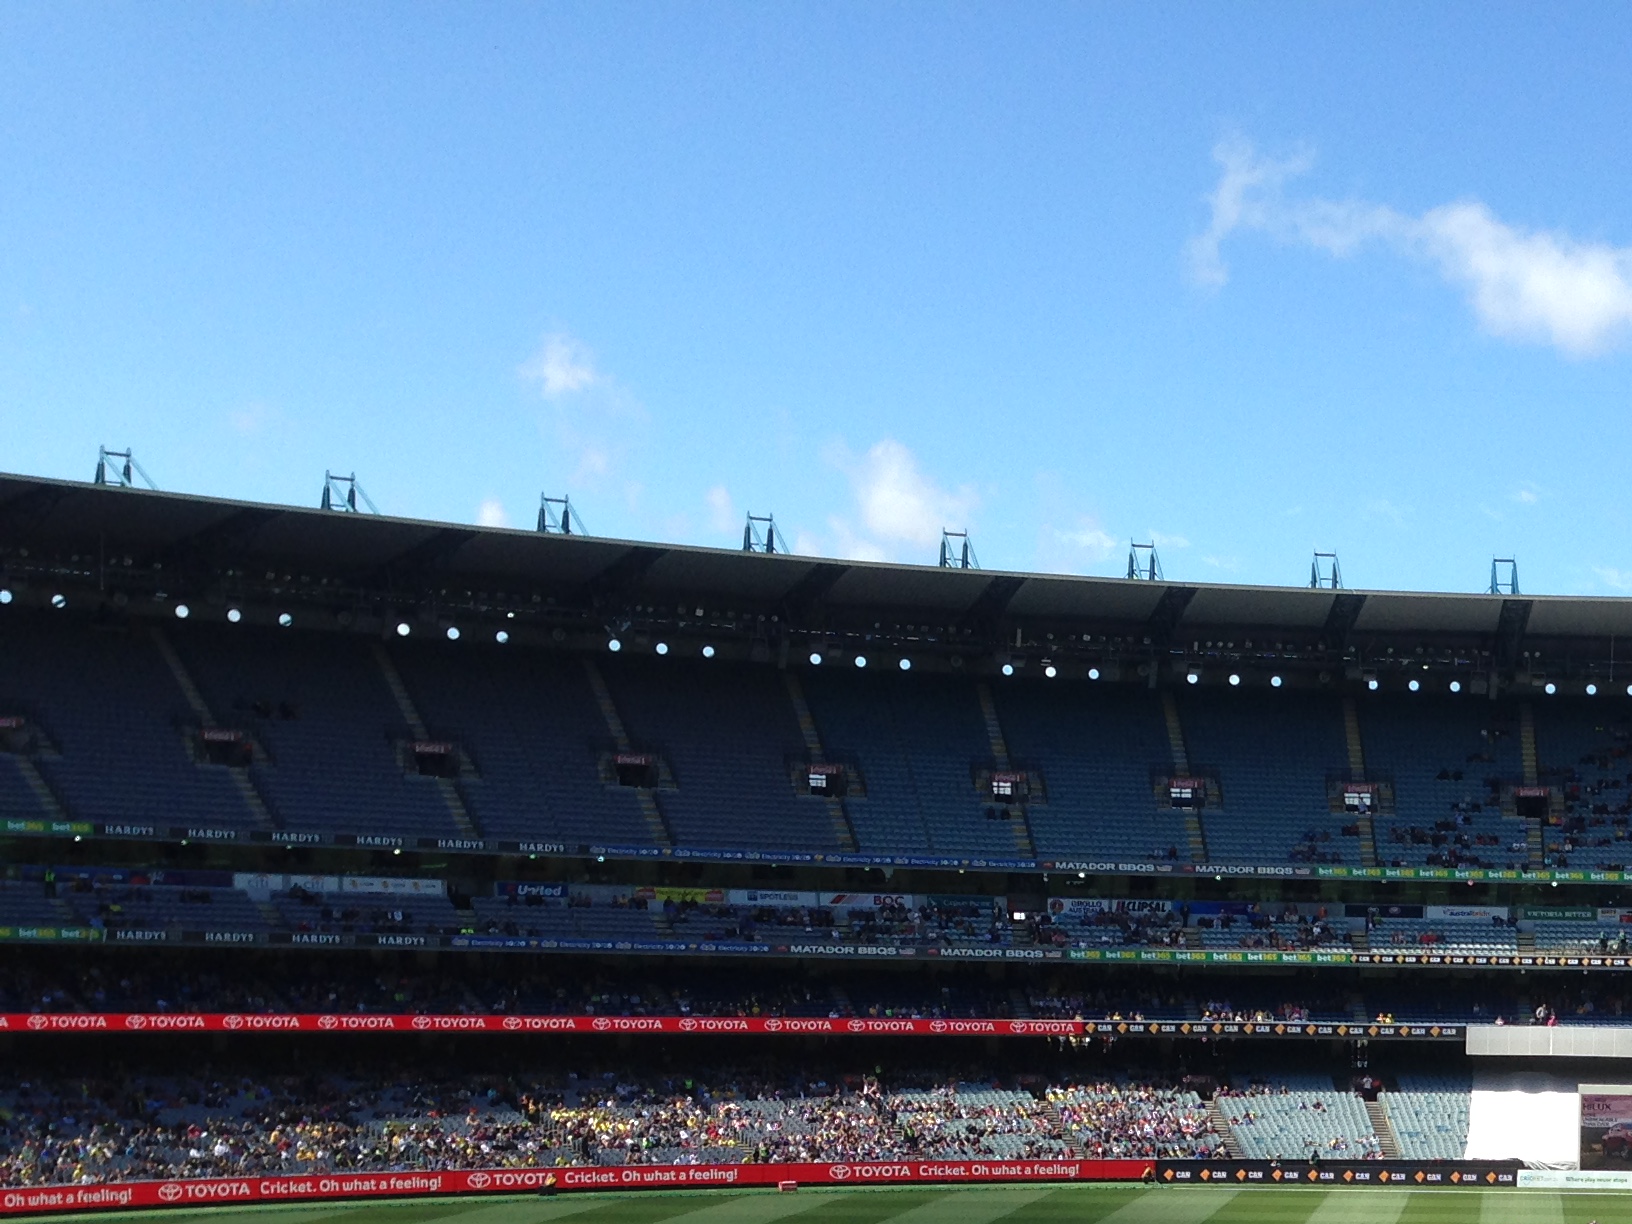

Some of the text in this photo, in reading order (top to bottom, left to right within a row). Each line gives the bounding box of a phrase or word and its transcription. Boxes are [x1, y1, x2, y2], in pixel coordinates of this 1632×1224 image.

[1056, 862, 1115, 870] MATADOR
[1126, 901, 1166, 912] CLIPSAL
[50, 1016, 106, 1027] TOYOTA
[245, 1017, 299, 1027] TOYOTA
[341, 1018, 394, 1027] TOYOTA
[434, 1018, 485, 1027] TOYOTA
[524, 1019, 575, 1028] TOYOTA
[613, 1020, 662, 1028] TOYOTA
[699, 1021, 748, 1029] TOYOTA
[784, 1021, 831, 1029] TOYOTA
[867, 1022, 913, 1030] TOYOTA
[950, 1022, 994, 1031] TOYOTA
[1029, 1023, 1074, 1031] TOYOTA
[853, 1166, 910, 1176] TOYOTA
[920, 1166, 969, 1175] Cricket.
[972, 1165, 989, 1175] Oh
[992, 1166, 1022, 1175] what
[1034, 1164, 1079, 1176] feeling!
[565, 1169, 737, 1182] Cricket. Oh what a feeling!
[186, 1183, 250, 1196] TOYOTA
[261, 1177, 441, 1193] Cricket. Oh what a feeling!
[5, 1190, 131, 1207] Oh what a feeling!
